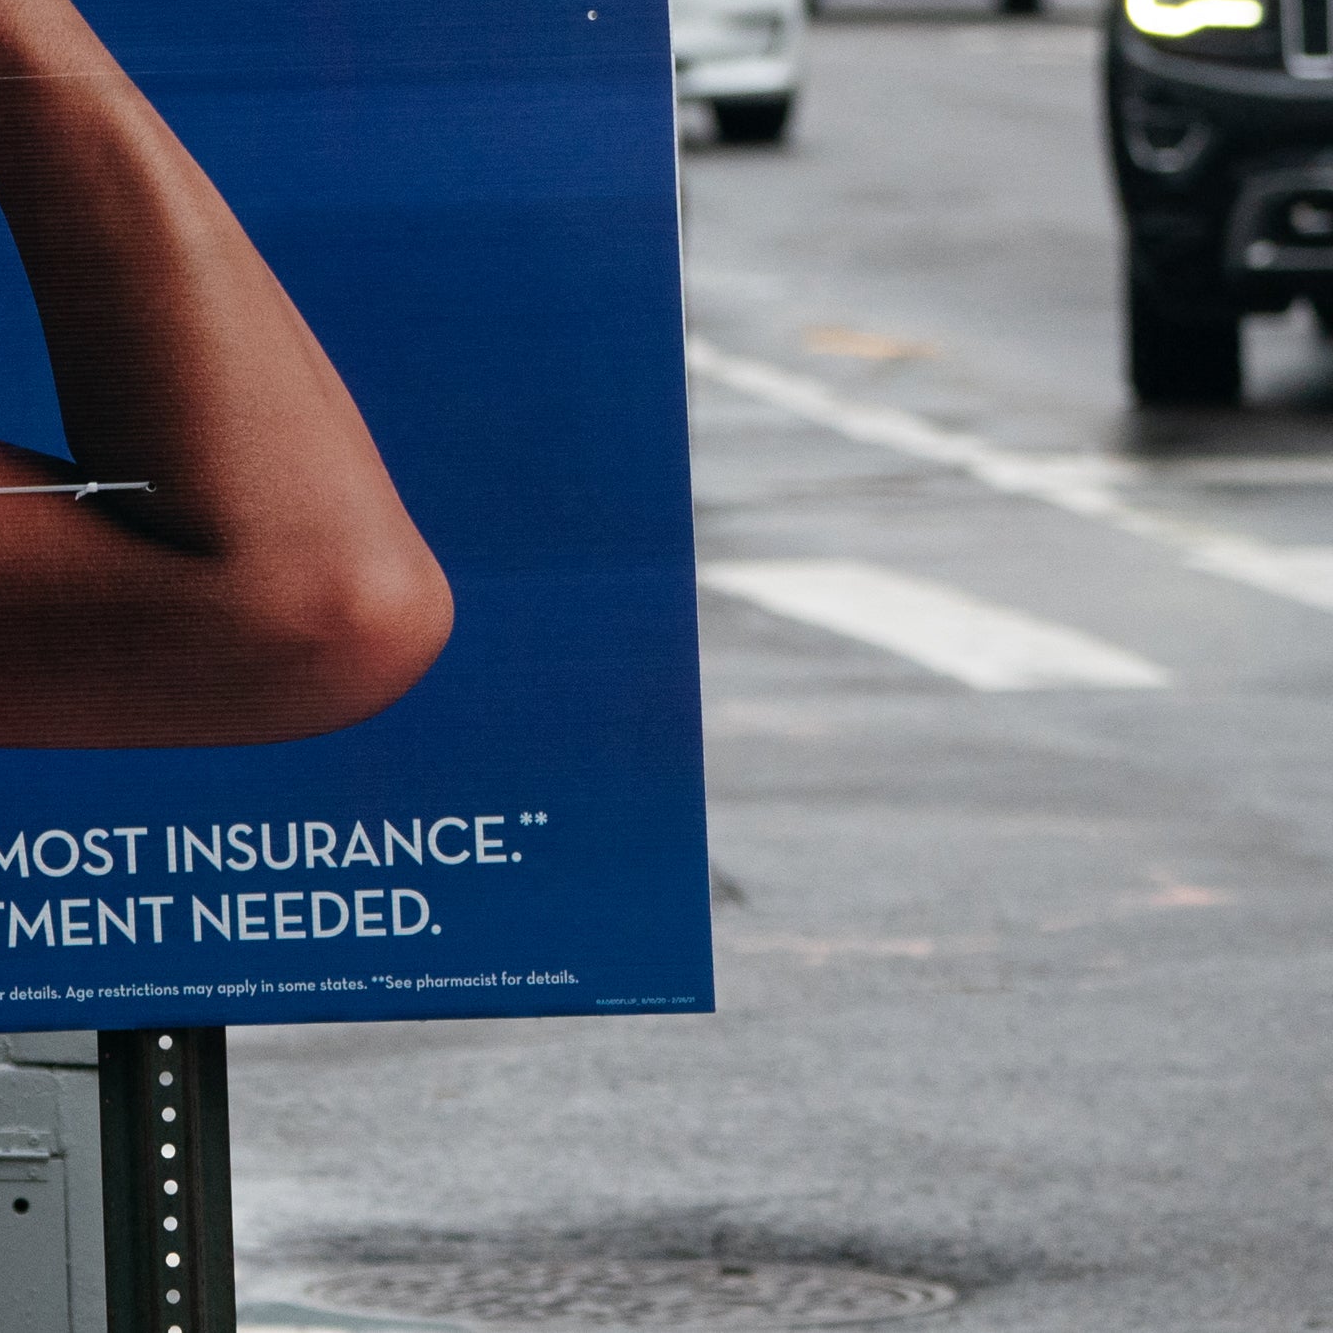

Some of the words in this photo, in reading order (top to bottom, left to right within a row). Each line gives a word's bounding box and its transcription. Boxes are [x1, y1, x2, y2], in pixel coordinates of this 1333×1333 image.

[193, 889, 441, 941] NEEDED.
[9, 985, 62, 1000] details.
[65, 986, 94, 1002] Age
[98, 983, 179, 998] restrictions
[183, 985, 213, 998] may
[217, 979, 257, 997] apply
[261, 979, 274, 993] in
[278, 981, 316, 993] some
[320, 977, 368, 991] states.
[416, 973, 497, 992] pharmacist
[501, 971, 522, 985] for
[526, 970, 579, 985] details.
